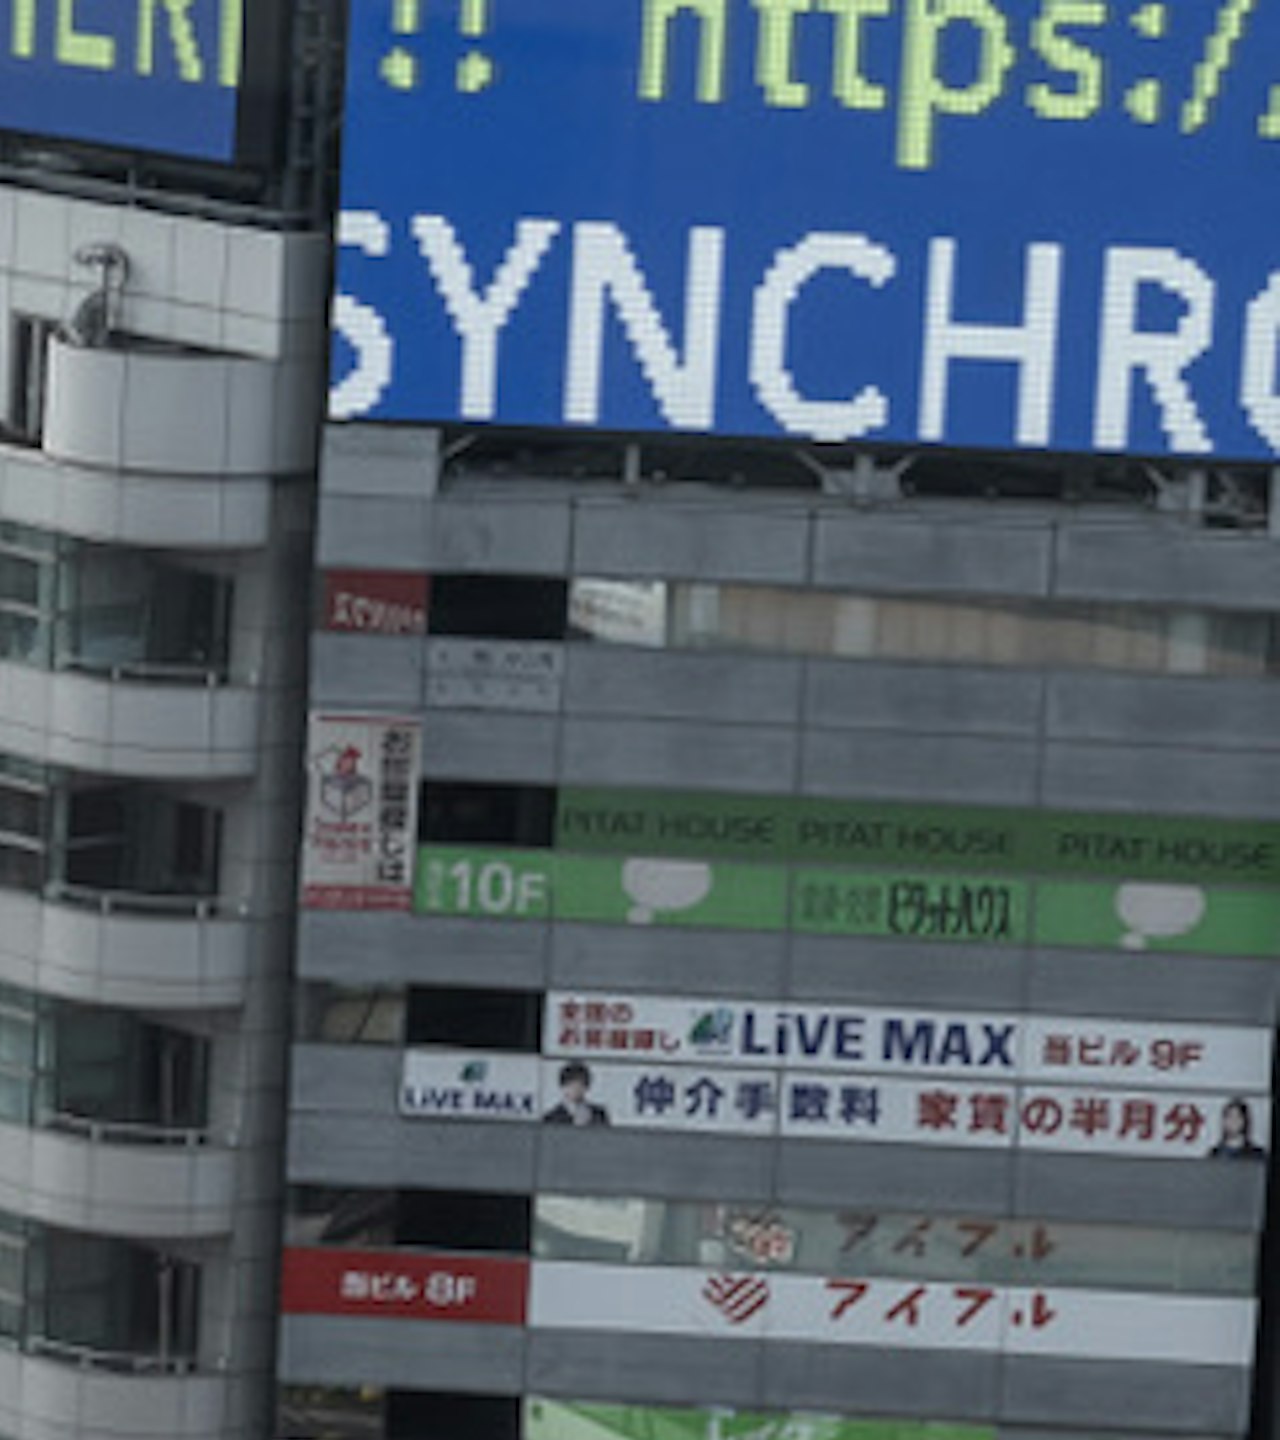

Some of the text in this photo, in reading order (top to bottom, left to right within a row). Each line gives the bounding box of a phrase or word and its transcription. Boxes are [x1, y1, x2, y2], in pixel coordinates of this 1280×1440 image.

[658, 812, 775, 846] HOUSE
[798, 818, 1010, 856] PITAT HOUSE
[1057, 831, 1279, 870] PITAT HOUSE
[451, 861, 547, 914] 10F
[882, 1017, 1019, 1068] MAX
[1149, 1039, 1206, 1071] 9F
[632, 1073, 1206, 1142] 仲介手数料 家賃の半月分
[426, 1271, 477, 1306] 8F
[824, 1279, 1058, 1329] アイフル
